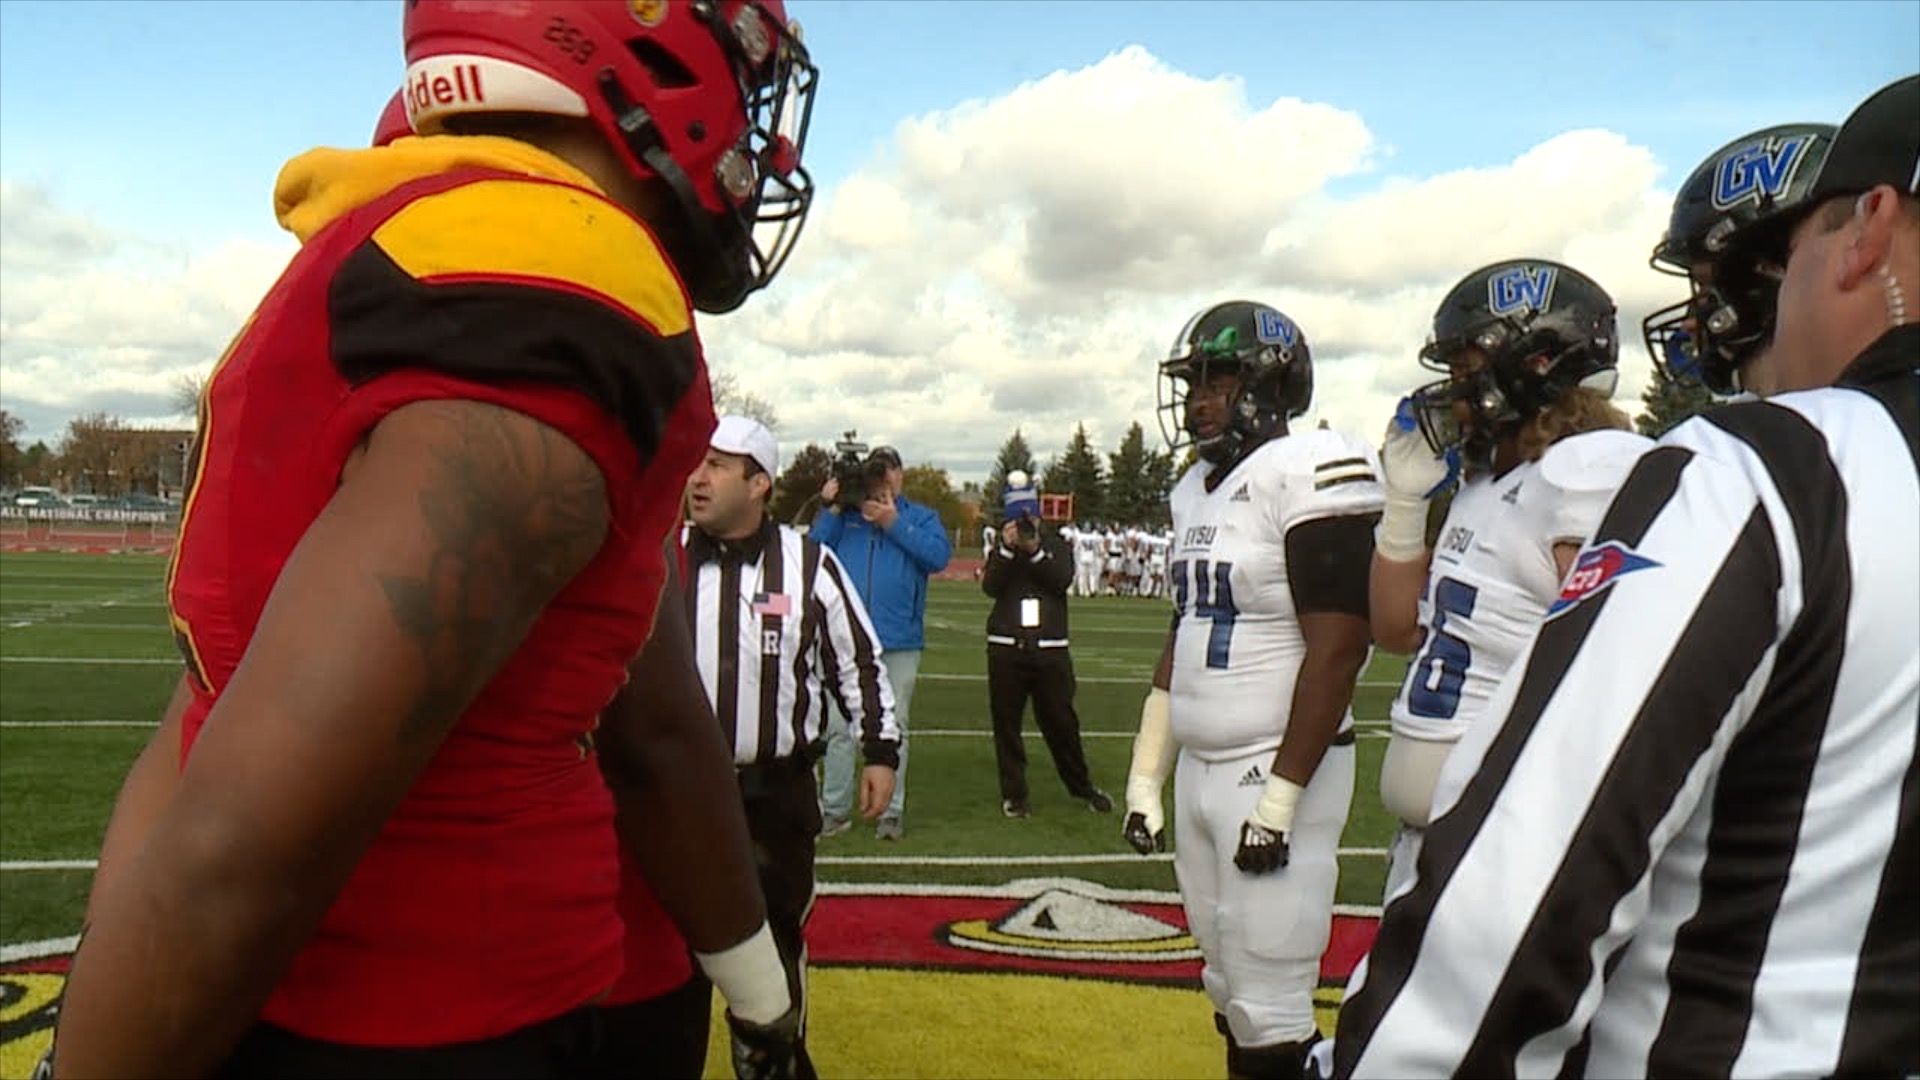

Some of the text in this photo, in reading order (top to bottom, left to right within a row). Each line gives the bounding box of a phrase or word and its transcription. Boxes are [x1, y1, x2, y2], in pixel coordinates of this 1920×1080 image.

[1714, 138, 1808, 204] GV
[1491, 266, 1556, 314] GV
[1257, 309, 1297, 347] GV
[29, 507, 92, 520] NATIONAL
[763, 630, 779, 655] R
